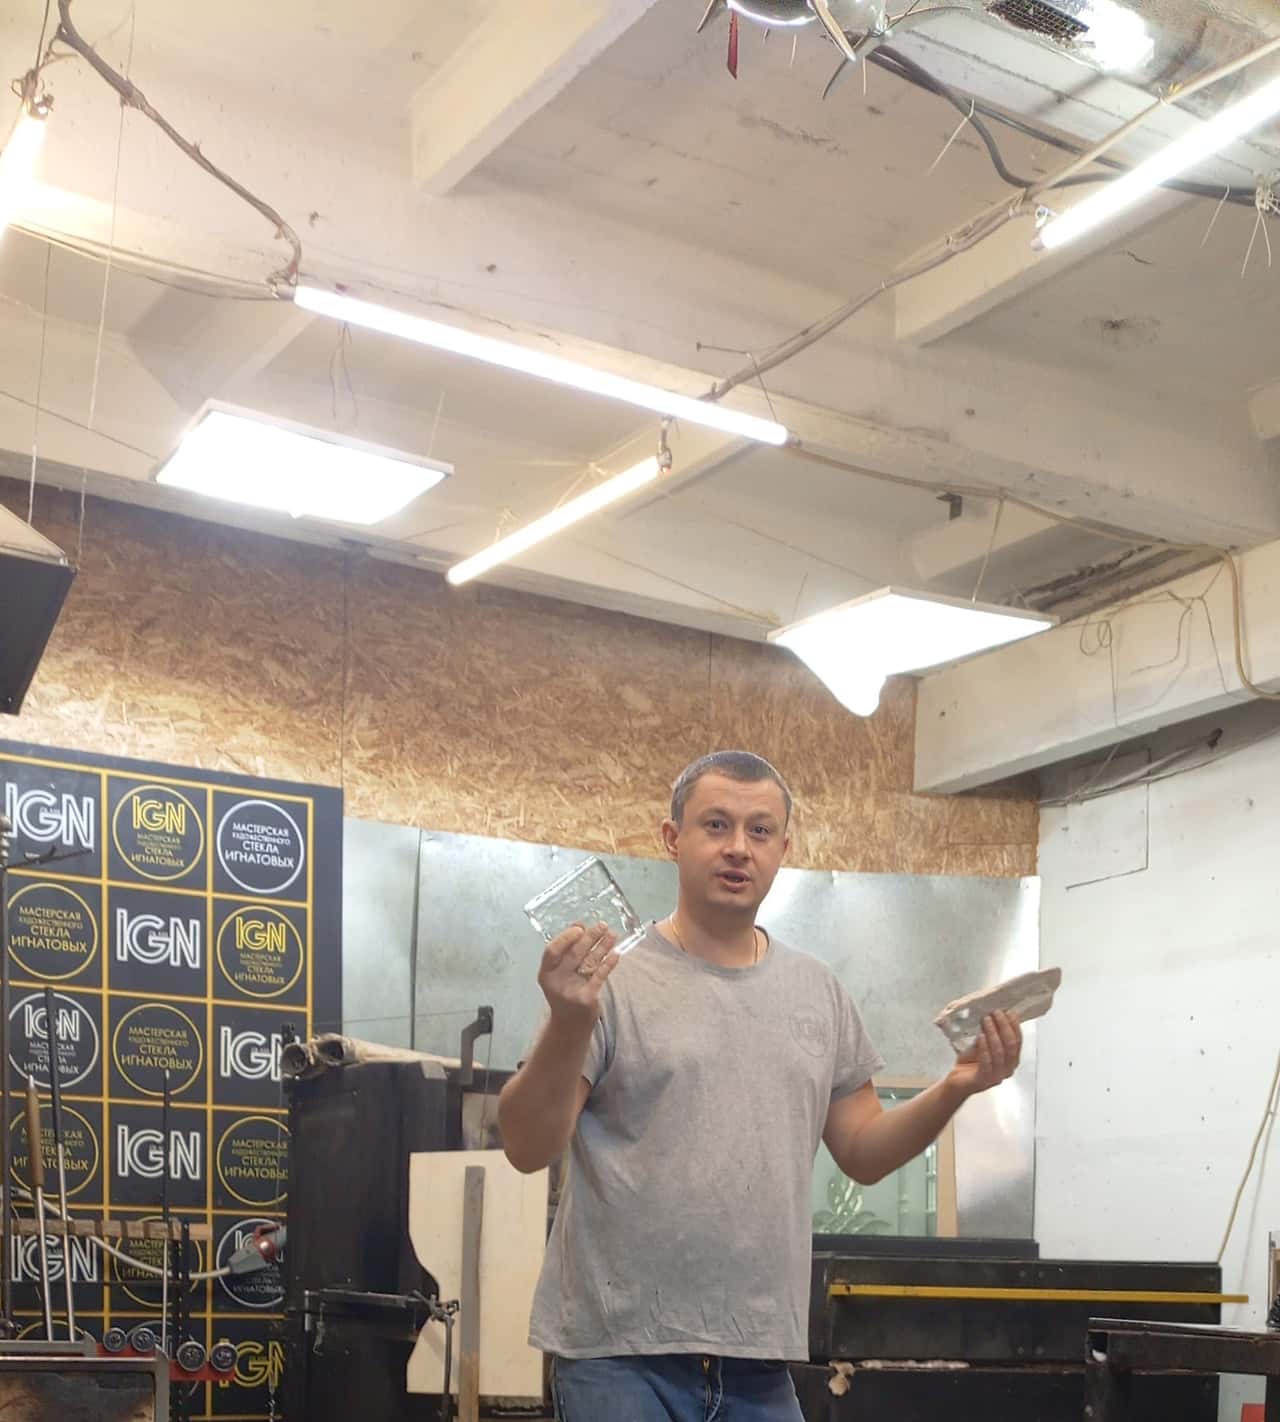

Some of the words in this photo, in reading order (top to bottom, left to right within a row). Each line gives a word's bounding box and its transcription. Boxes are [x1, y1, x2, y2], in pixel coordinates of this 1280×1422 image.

[5, 781, 95, 849] IGN
[133, 795, 185, 835] IGN
[232, 822, 289, 837] МАСТЕРСКАЯ
[242, 841, 279, 855] СТЕКЛА
[225, 849, 294, 869] ИГНАТОВЫХ
[19, 906, 81, 920] МАСТЕРСКАЯ
[30, 925, 71, 939] СТЕКЛА
[116, 907, 200, 969] IGN
[236, 916, 286, 953] IGN
[11, 935, 87, 953] ИГНАТОВЫХ
[129, 1026, 187, 1039] МАСТЕРСКАЯ
[140, 1044, 177, 1056] СТЕКЛА
[121, 1054, 193, 1070] ИГНАТОВЫХ
[117, 1124, 200, 1180] IGN
[11, 1234, 97, 1282] IGN
